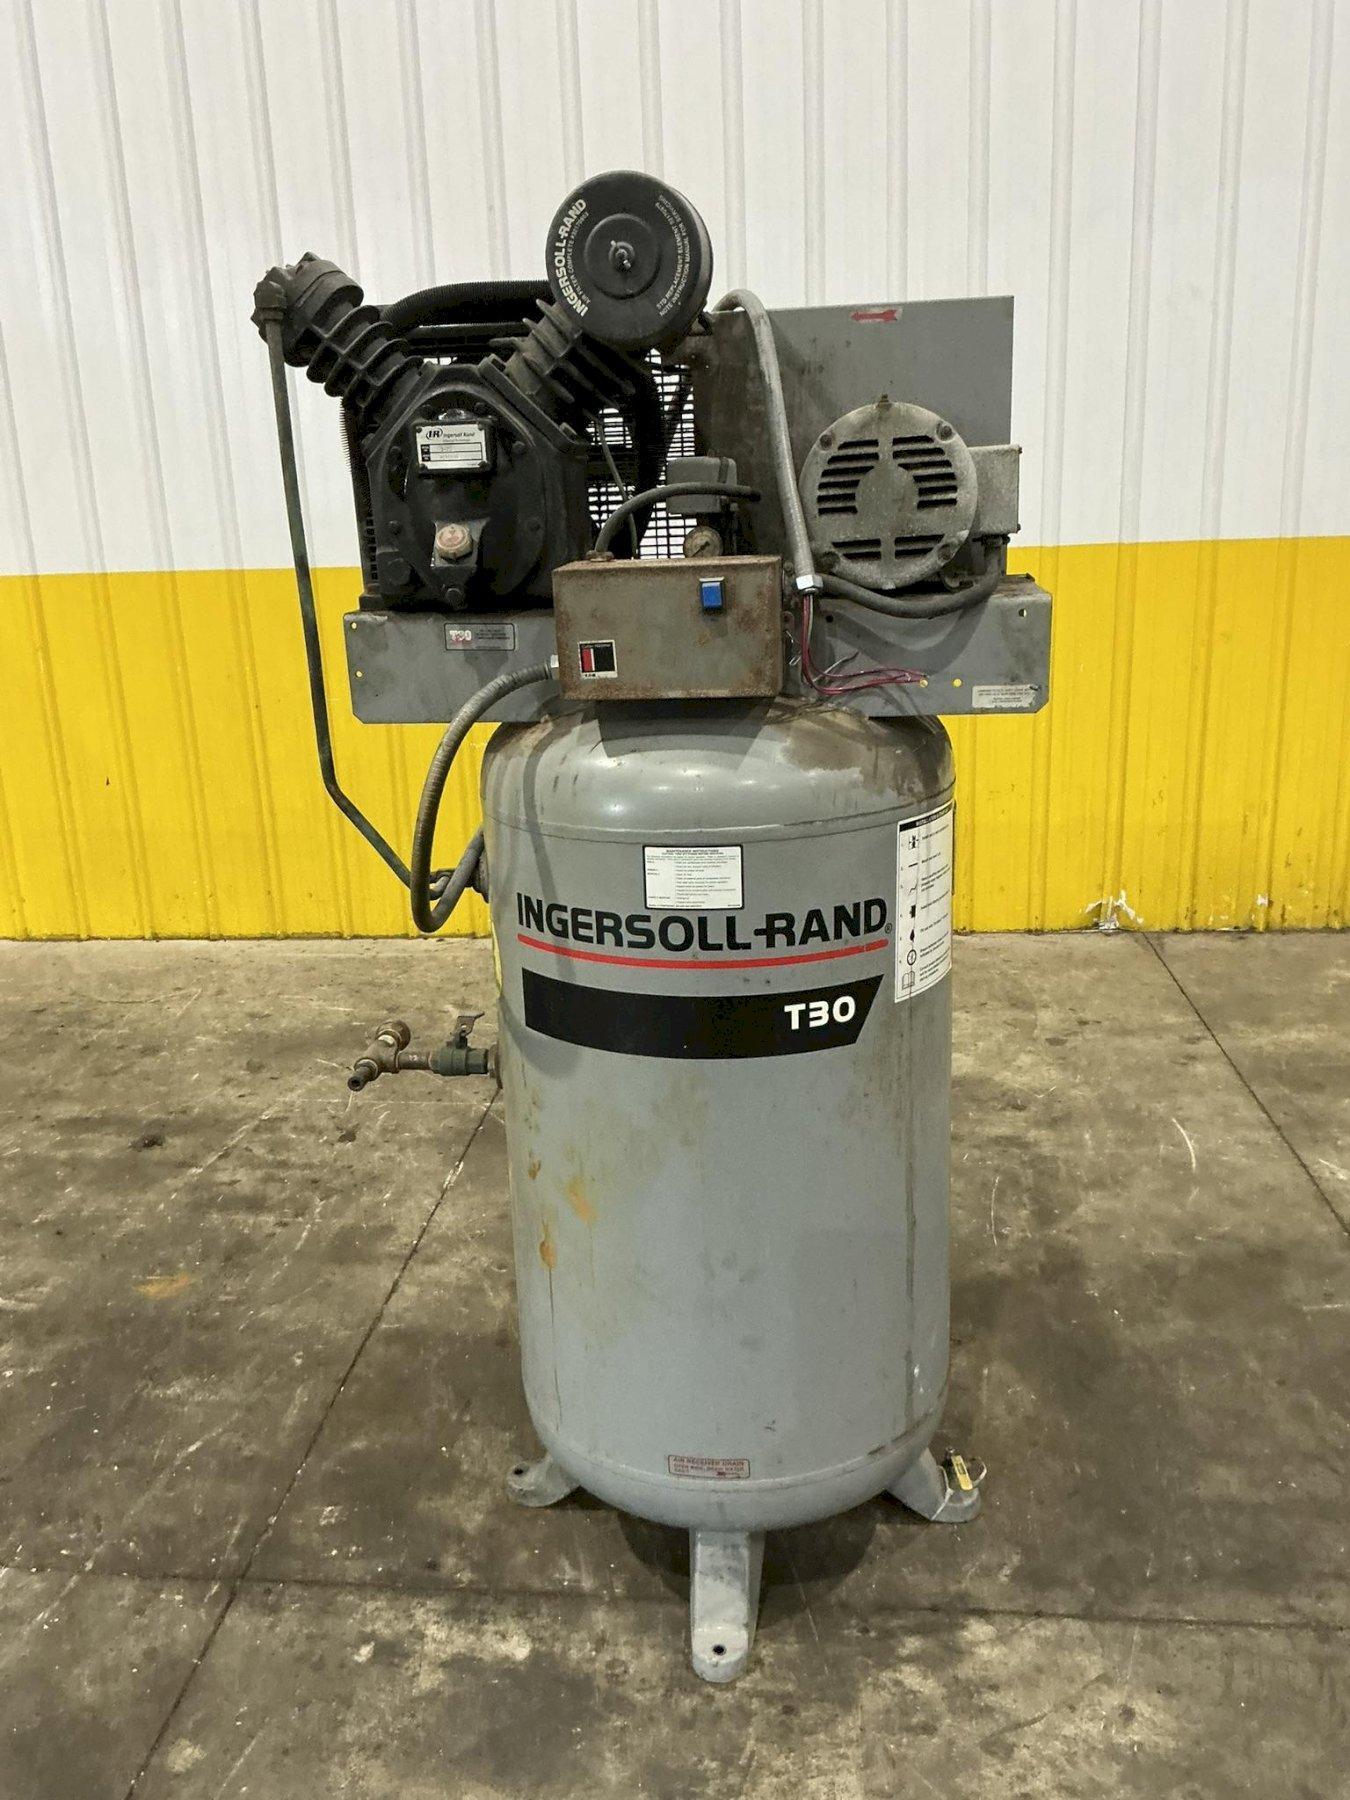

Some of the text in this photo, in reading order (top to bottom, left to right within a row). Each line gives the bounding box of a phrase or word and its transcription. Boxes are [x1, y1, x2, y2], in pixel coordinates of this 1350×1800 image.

[554, 199, 588, 317] INGERSOLL-RAND
[566, 239, 574, 273] COMPLETE
[570, 274, 583, 295] FILTER
[671, 263, 690, 304] INSTRUCTION
[517, 893, 888, 952] INGERSOLL-RAND
[784, 996, 857, 1031] T30
